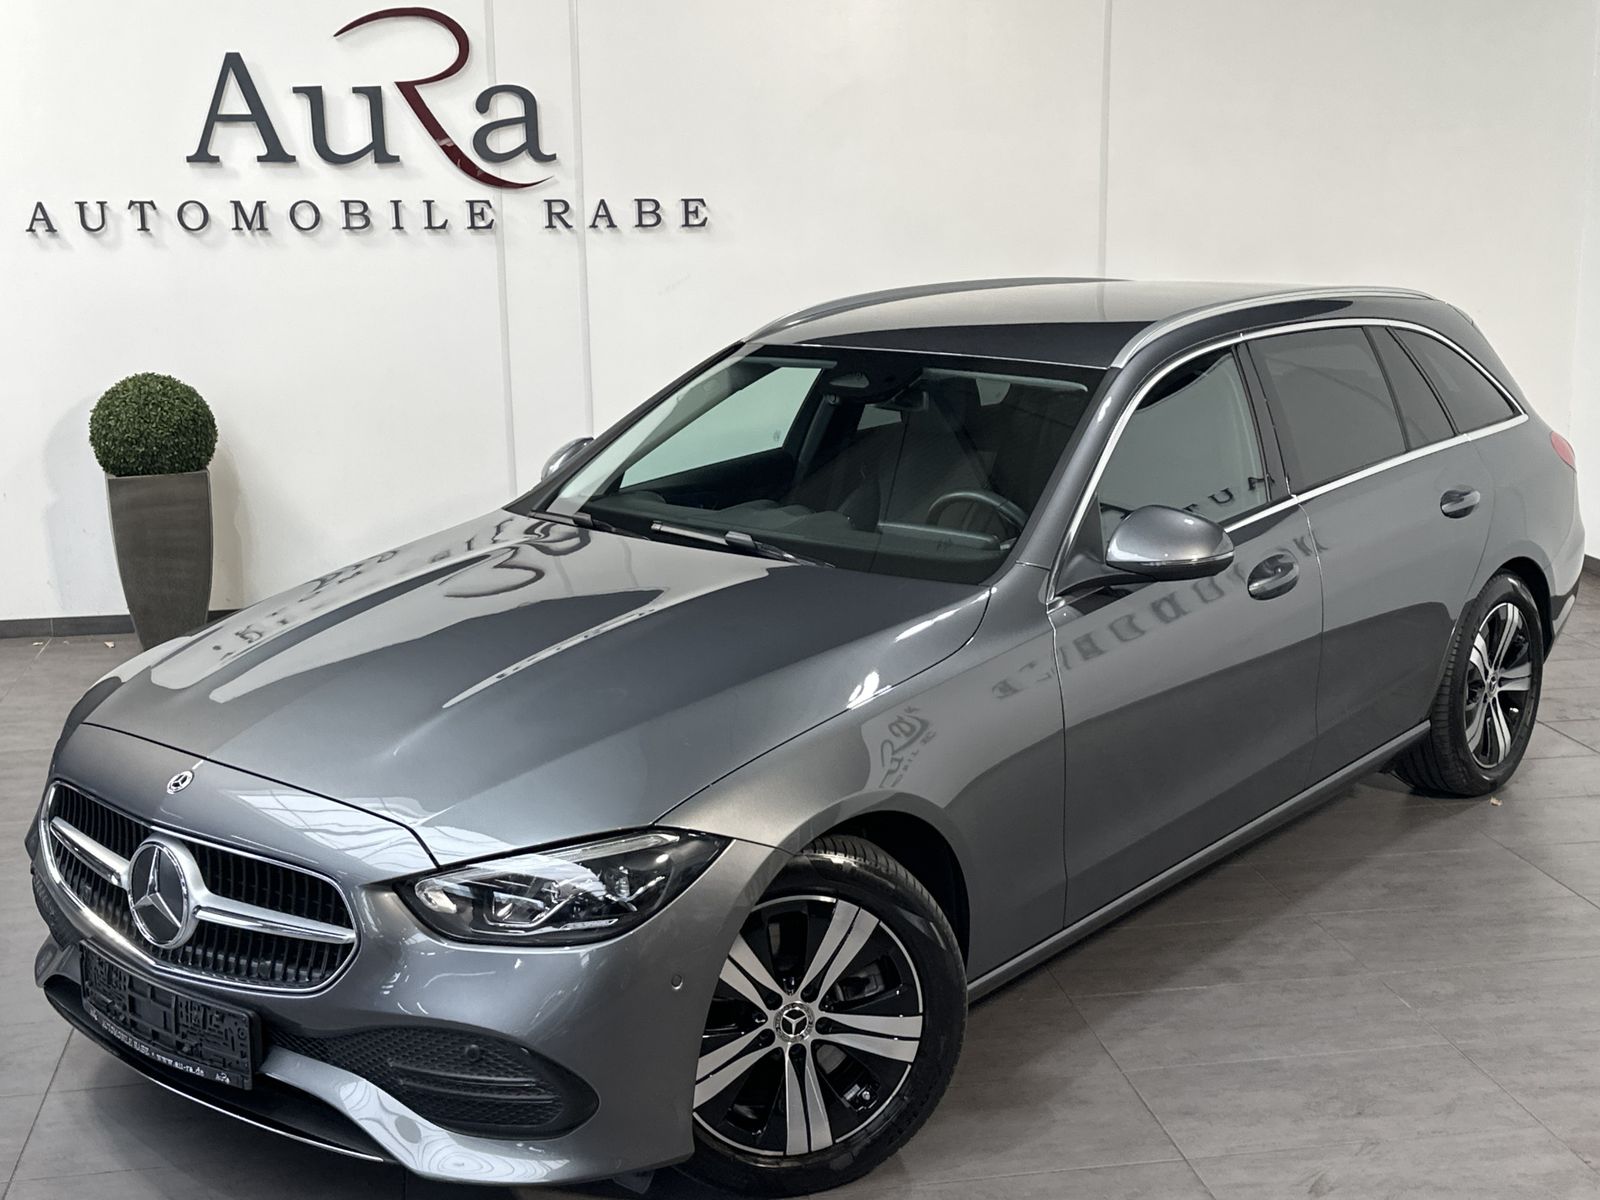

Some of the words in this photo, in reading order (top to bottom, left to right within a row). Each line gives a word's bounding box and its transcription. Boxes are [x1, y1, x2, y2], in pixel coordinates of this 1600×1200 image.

[186, 7, 558, 189] AuRa
[25, 200, 496, 235] AUTOMOBILE
[544, 198, 709, 229] RABE
